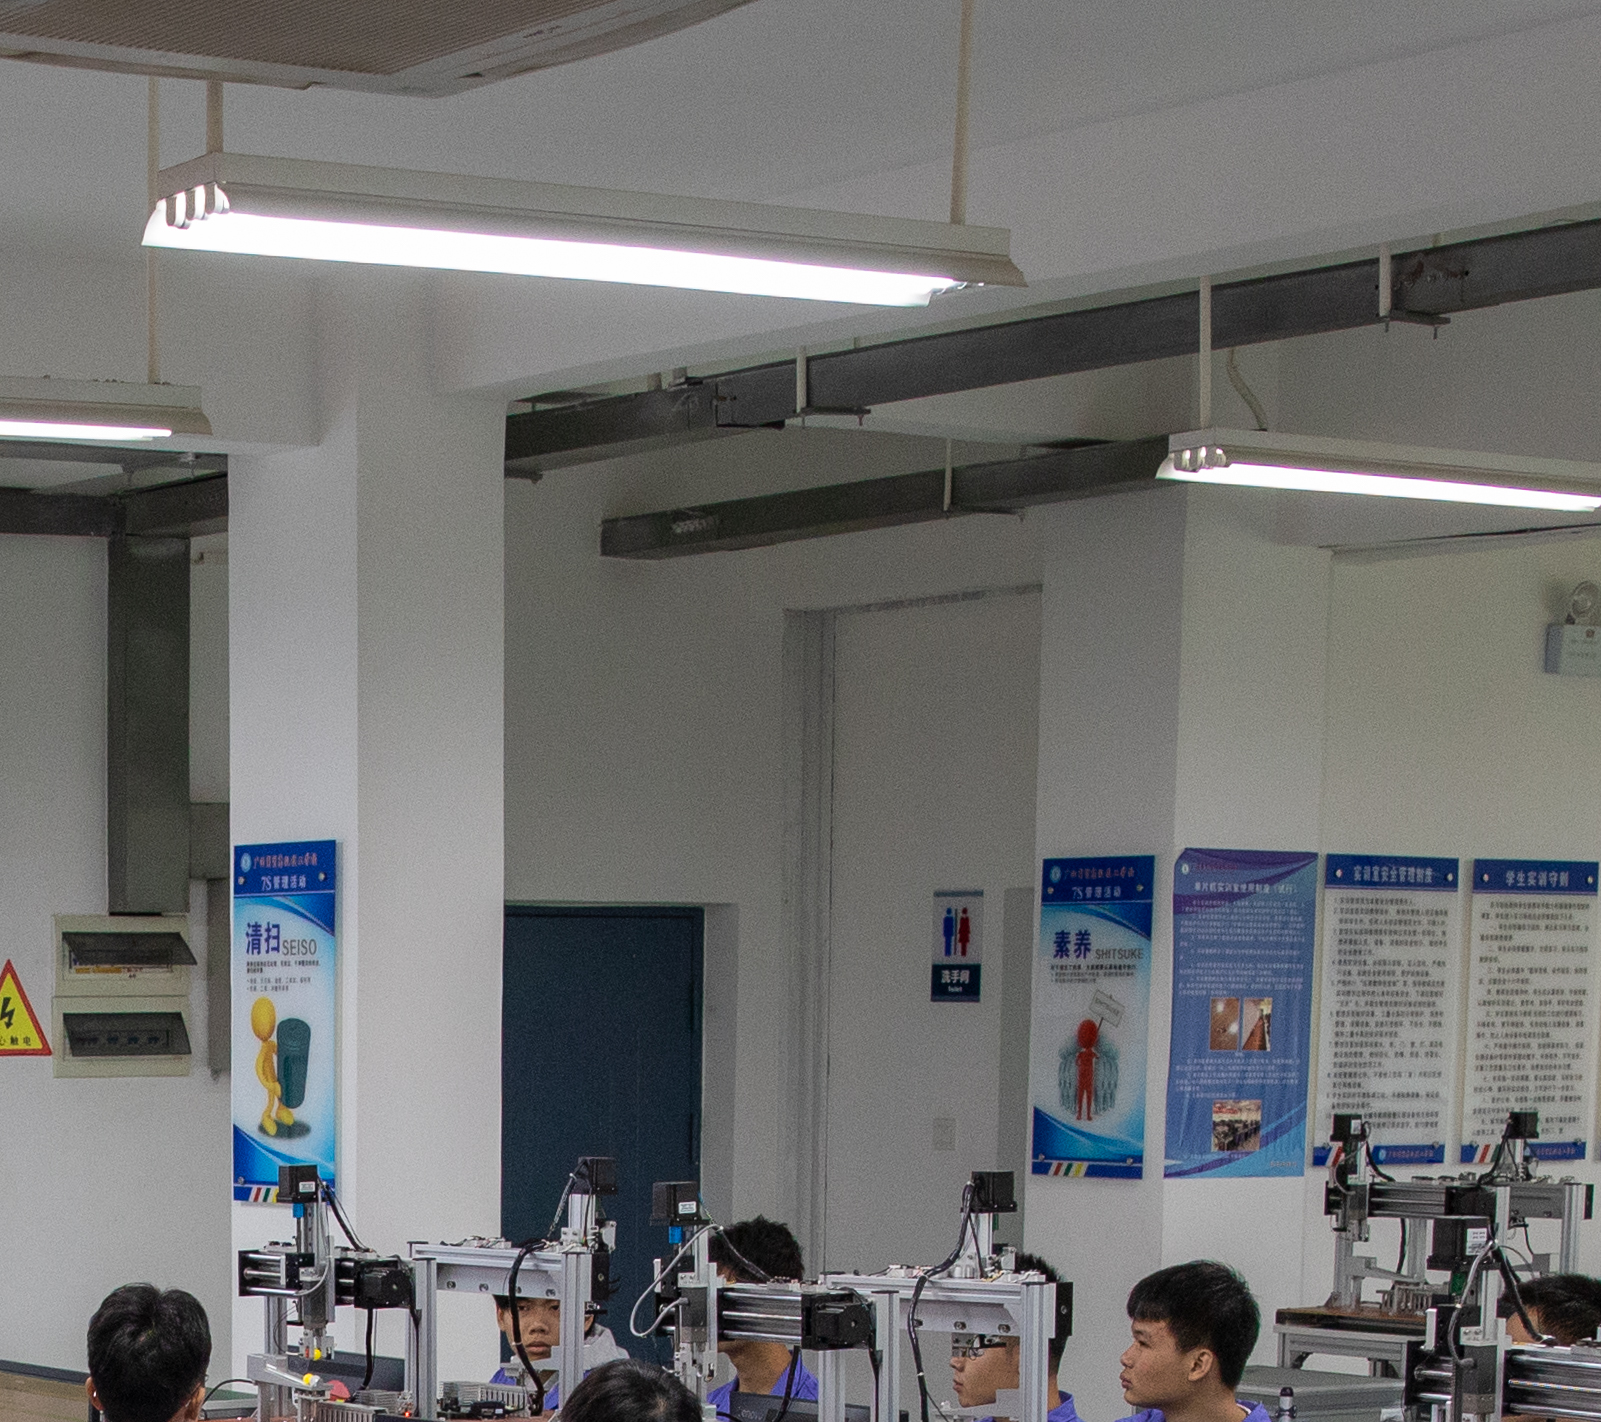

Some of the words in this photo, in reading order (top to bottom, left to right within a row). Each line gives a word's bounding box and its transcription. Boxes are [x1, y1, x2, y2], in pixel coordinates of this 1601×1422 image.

[245, 920, 280, 956] 清扫
[282, 939, 317, 956] SEISO
[1053, 929, 1093, 960] 素养
[1094, 948, 1145, 961] SHITSUKE
